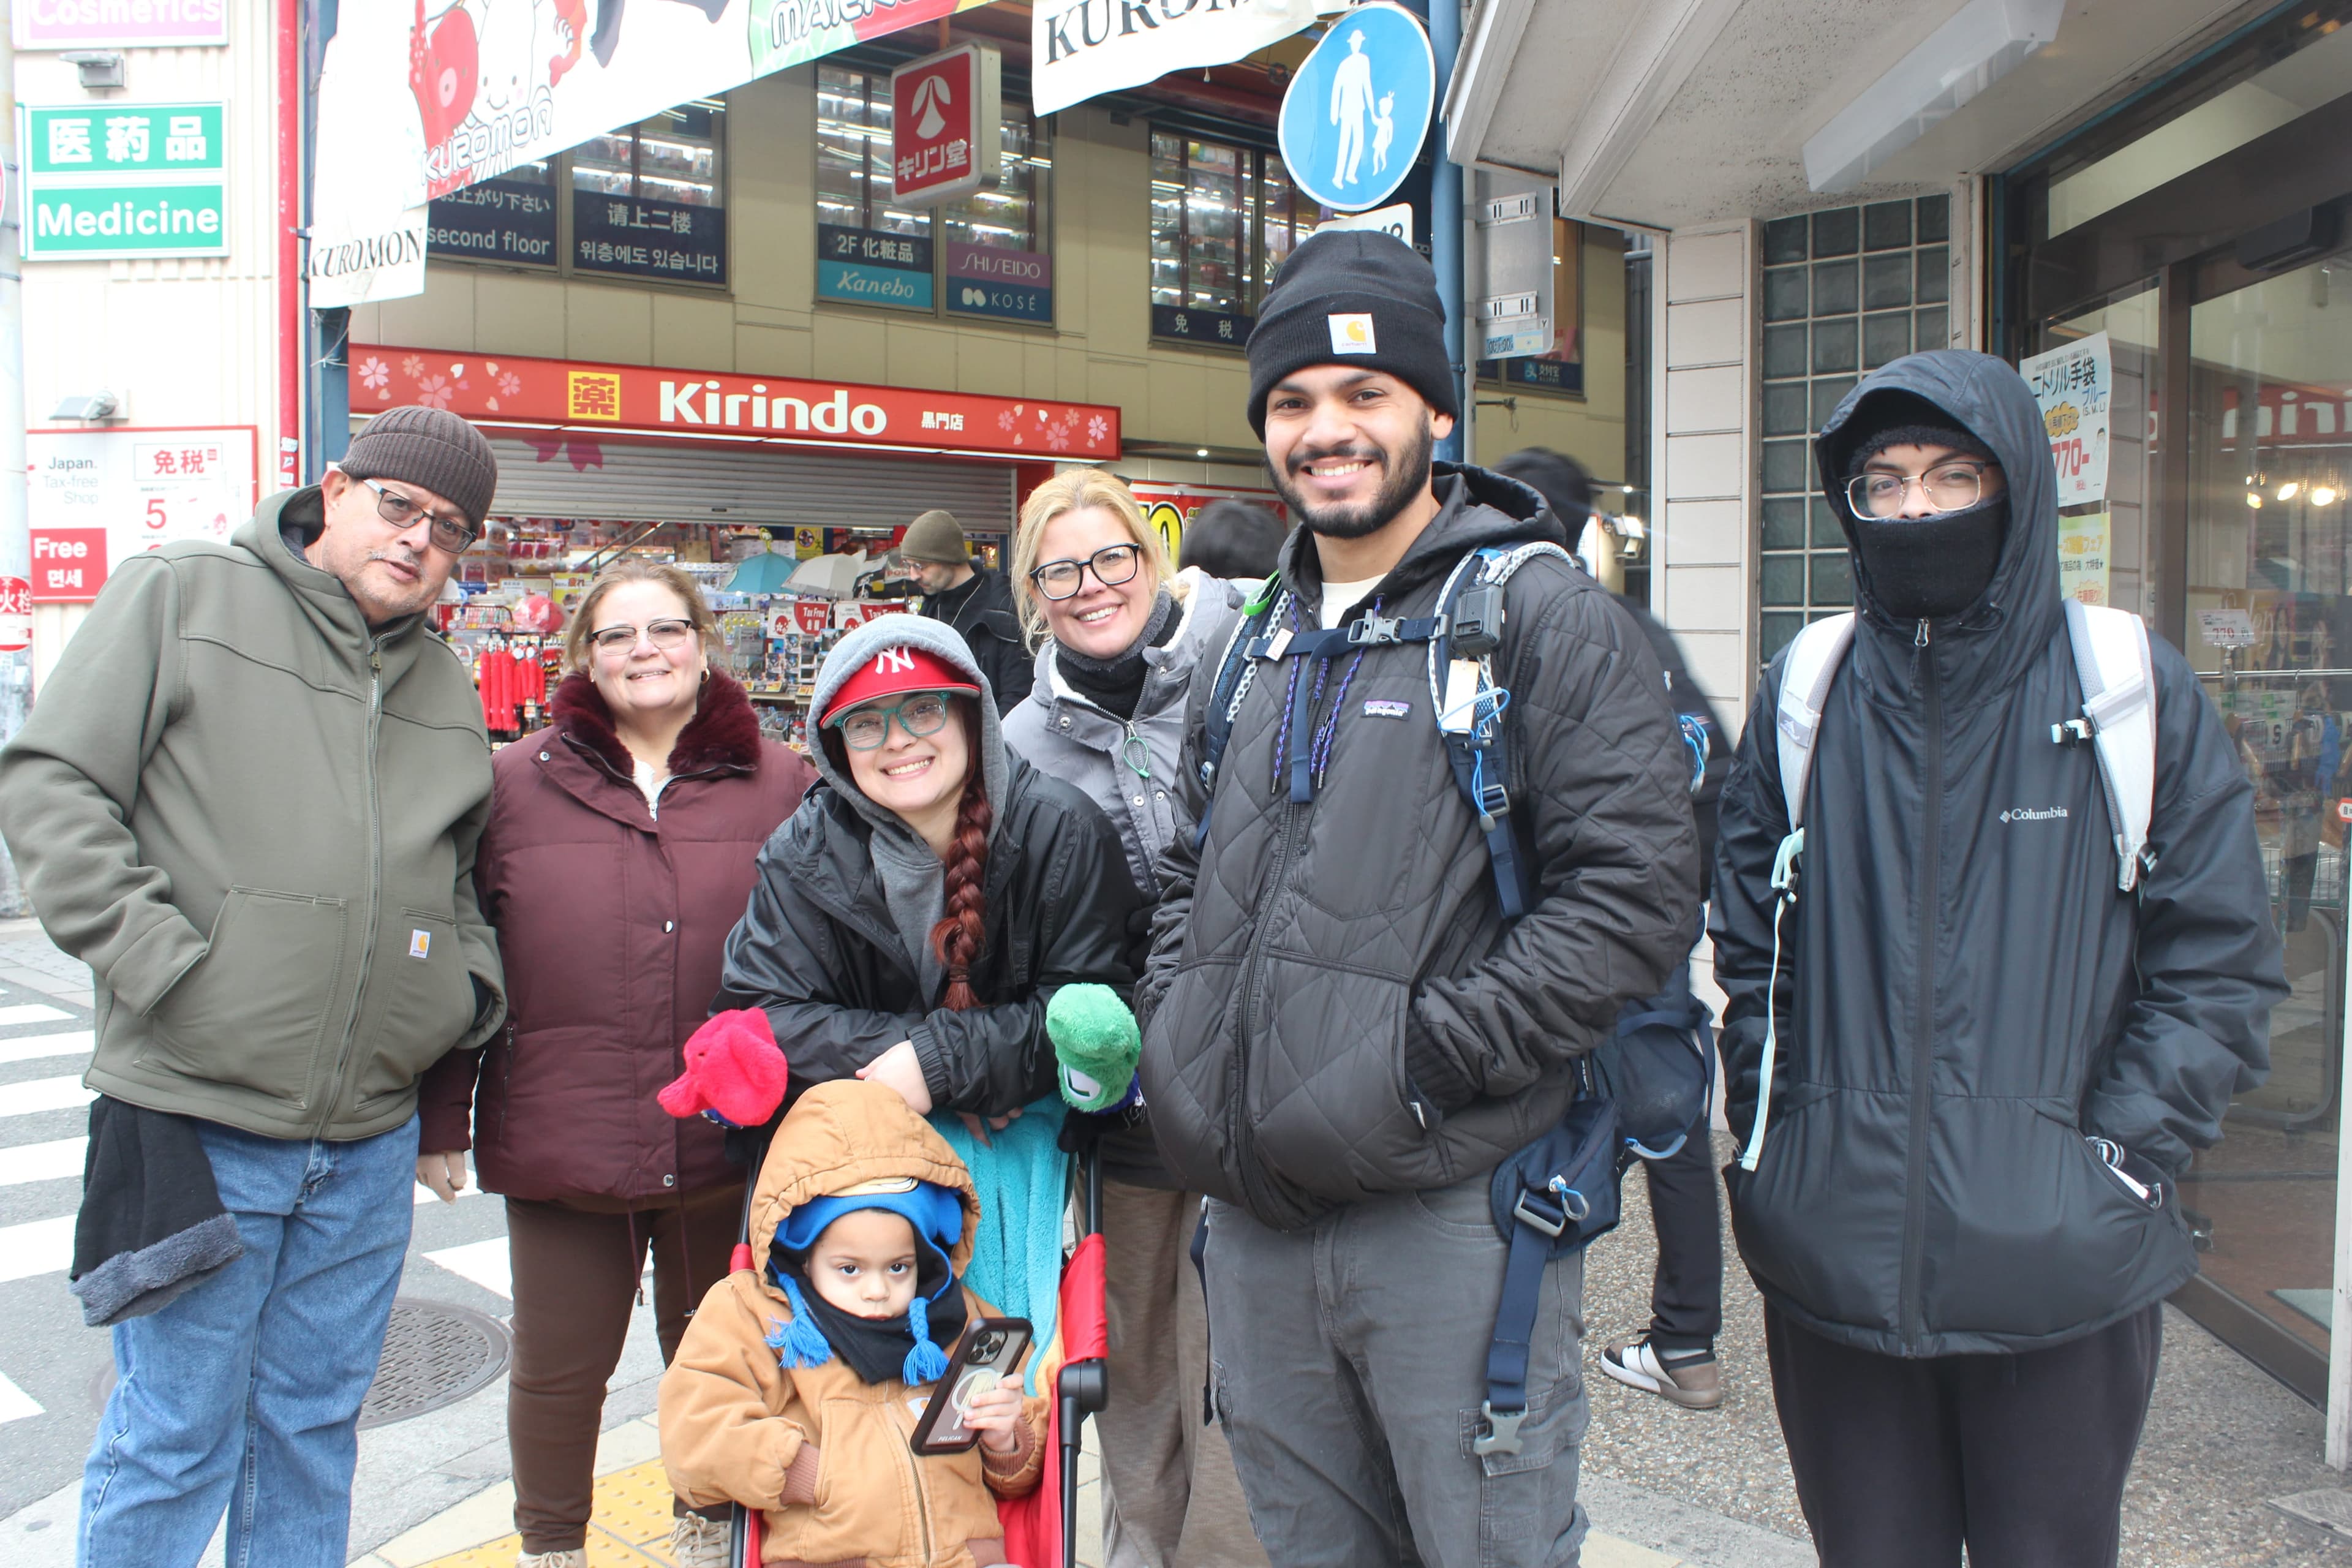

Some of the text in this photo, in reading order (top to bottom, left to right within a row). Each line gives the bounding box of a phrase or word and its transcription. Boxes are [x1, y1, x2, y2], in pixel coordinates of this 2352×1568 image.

[421, 98, 553, 186] KUROMON
[897, 138, 968, 182] キリン堂
[37, 201, 219, 237] Medicine
[608, 203, 692, 235] 请上二楼
[311, 228, 423, 277] KUROMON
[428, 227, 551, 255] second floor
[837, 234, 914, 263] 2F 化粧品
[581, 240, 719, 274] 위층에도 있습니다
[959, 252, 1041, 279] SHISEIDO
[837, 270, 914, 299] Kanebo
[2032, 357, 2097, 399] ニトリル手袋
[660, 380, 888, 435] Kirindo
[921, 410, 964, 431] 黒門店
[154, 449, 205, 475] 免税
[146, 499, 167, 529] 5
[34, 538, 88, 559] Free
[48, 568, 83, 588] 면세
[803, 607, 814, 617] Tax
[2011, 806, 2068, 820] Columbia
